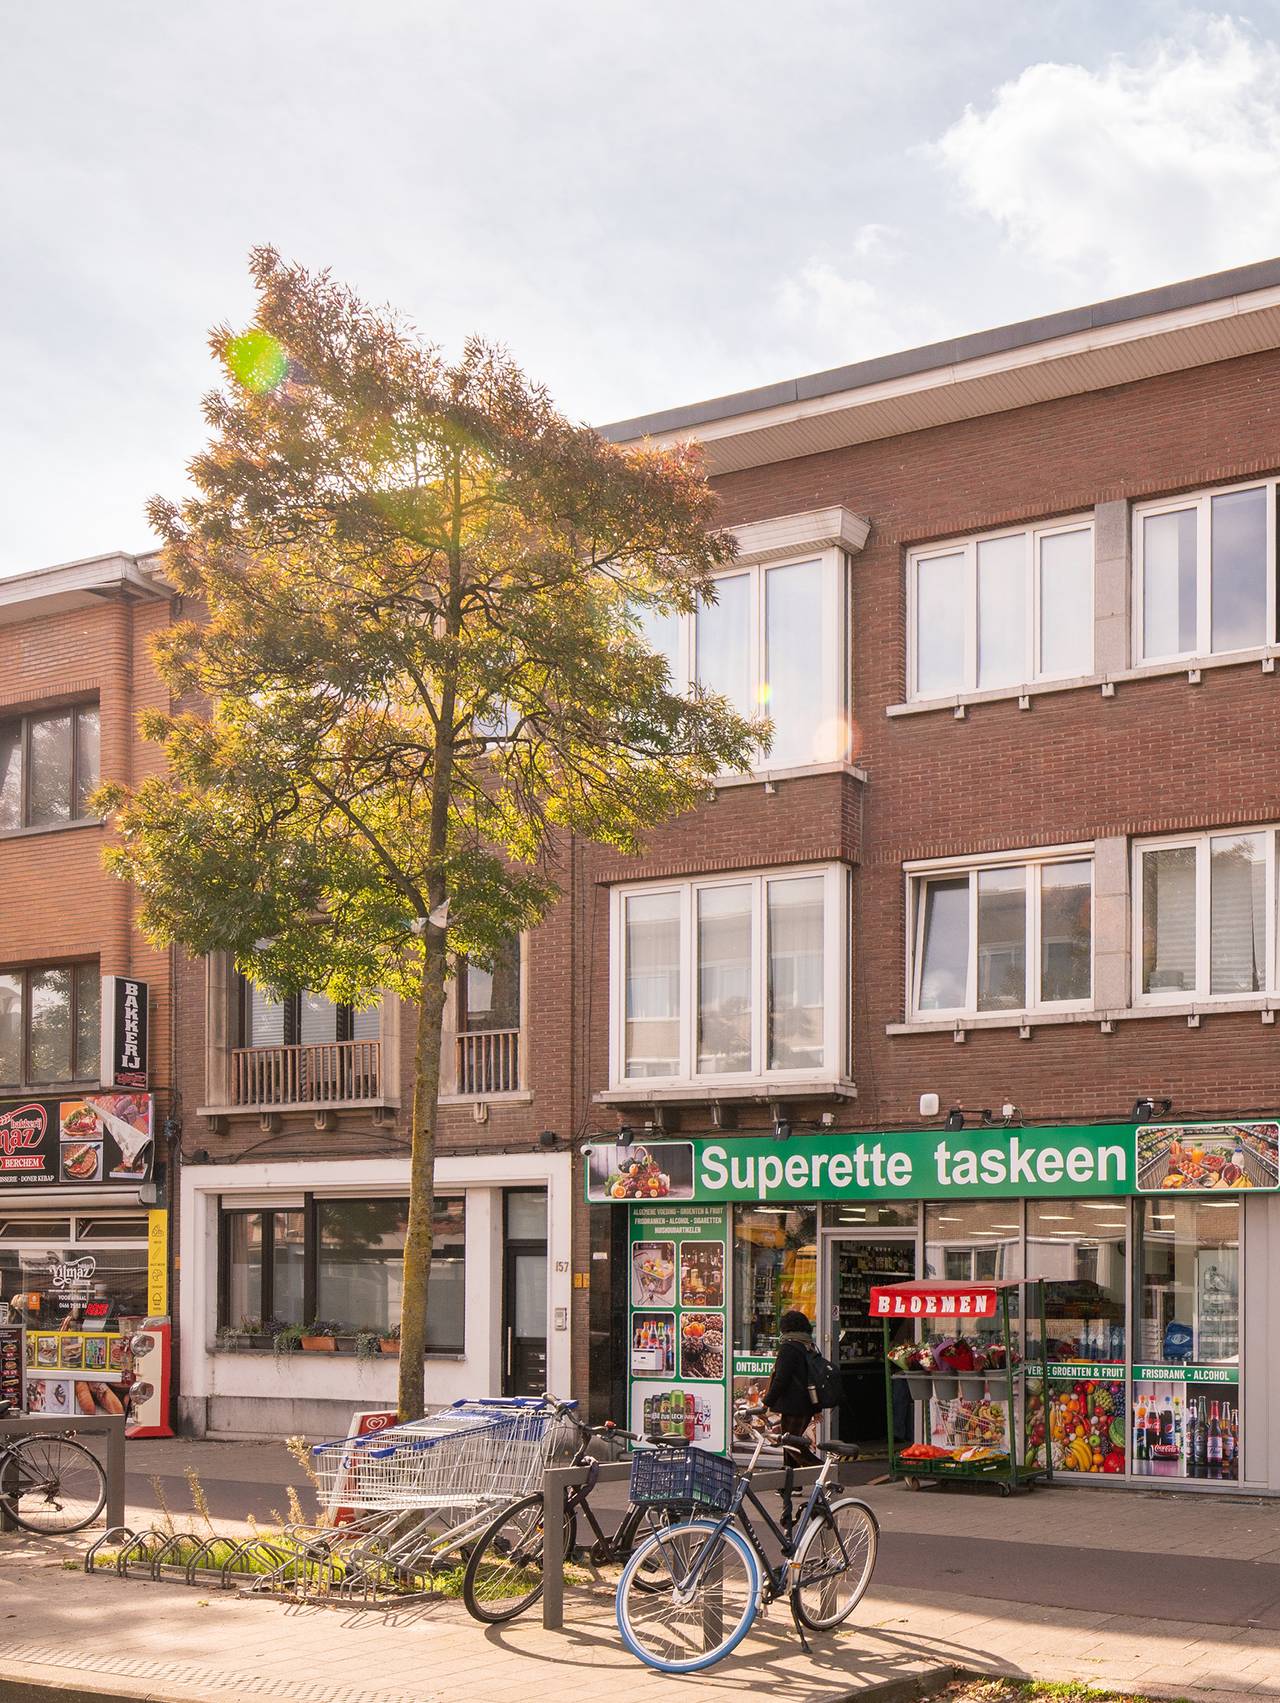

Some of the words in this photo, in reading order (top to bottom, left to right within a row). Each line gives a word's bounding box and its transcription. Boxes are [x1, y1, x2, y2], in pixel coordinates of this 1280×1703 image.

[121, 982, 141, 1069] BAKKERIJ
[5, 1158, 40, 1168] BERCHEM
[700, 1142, 913, 1199] Superette
[934, 1136, 1127, 1186] taskeen
[555, 1261, 569, 1273] 157
[878, 1295, 988, 1314] BLOEMEN
[736, 1361, 775, 1373] ONTBIJTP
[1027, 1365, 1050, 1376] VERE
[1052, 1366, 1092, 1377] GROENTEN
[1093, 1367, 1099, 1377] &
[1101, 1367, 1124, 1378] FRUIT
[1141, 1368, 1186, 1379] FRISDRANK
[1193, 1370, 1230, 1381] ALCOHOL
